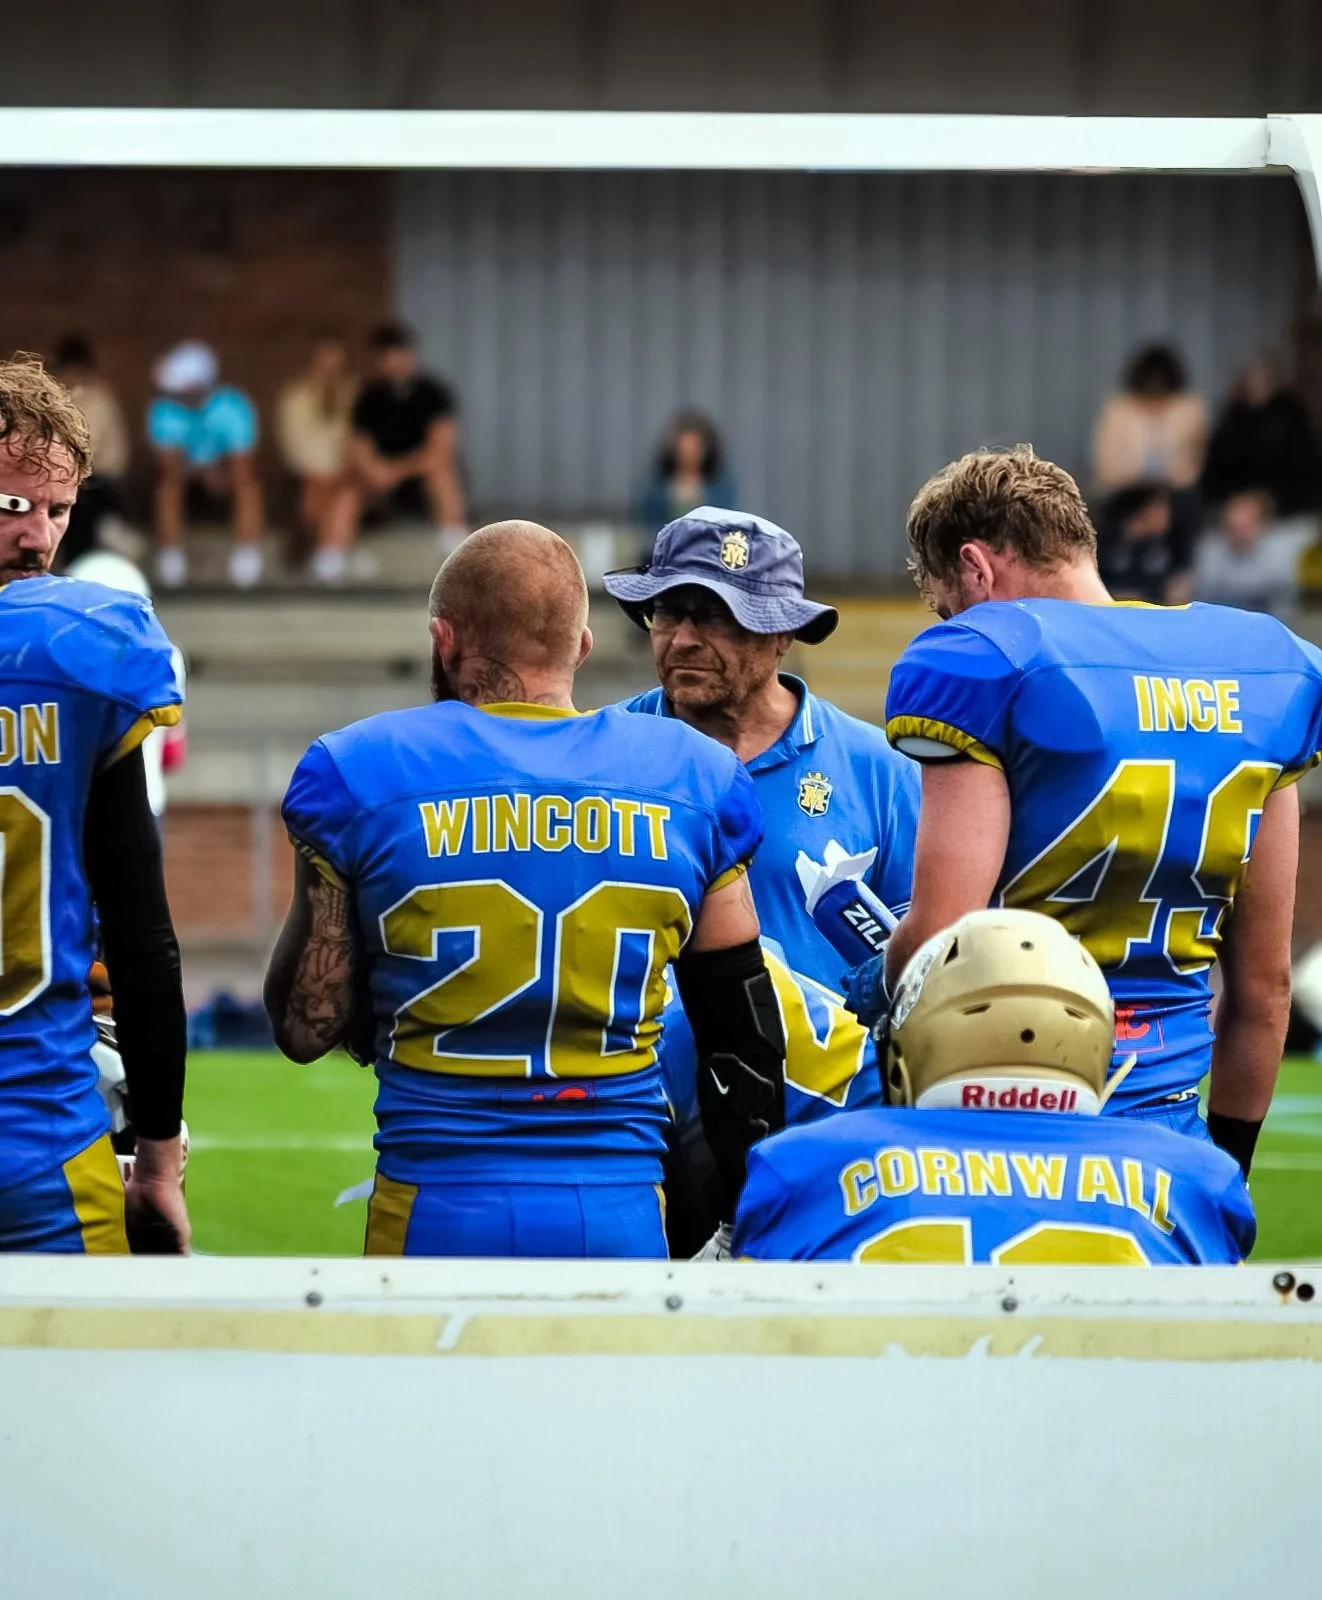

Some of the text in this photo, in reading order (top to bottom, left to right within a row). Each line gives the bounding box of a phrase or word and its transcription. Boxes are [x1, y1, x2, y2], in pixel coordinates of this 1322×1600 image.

[1133, 675, 1243, 734] INCE
[418, 794, 670, 861] WINCOTT
[379, 878, 693, 1078] 20
[962, 1085, 1077, 1112] Riddell
[839, 1147, 1176, 1235] CORNWALL
